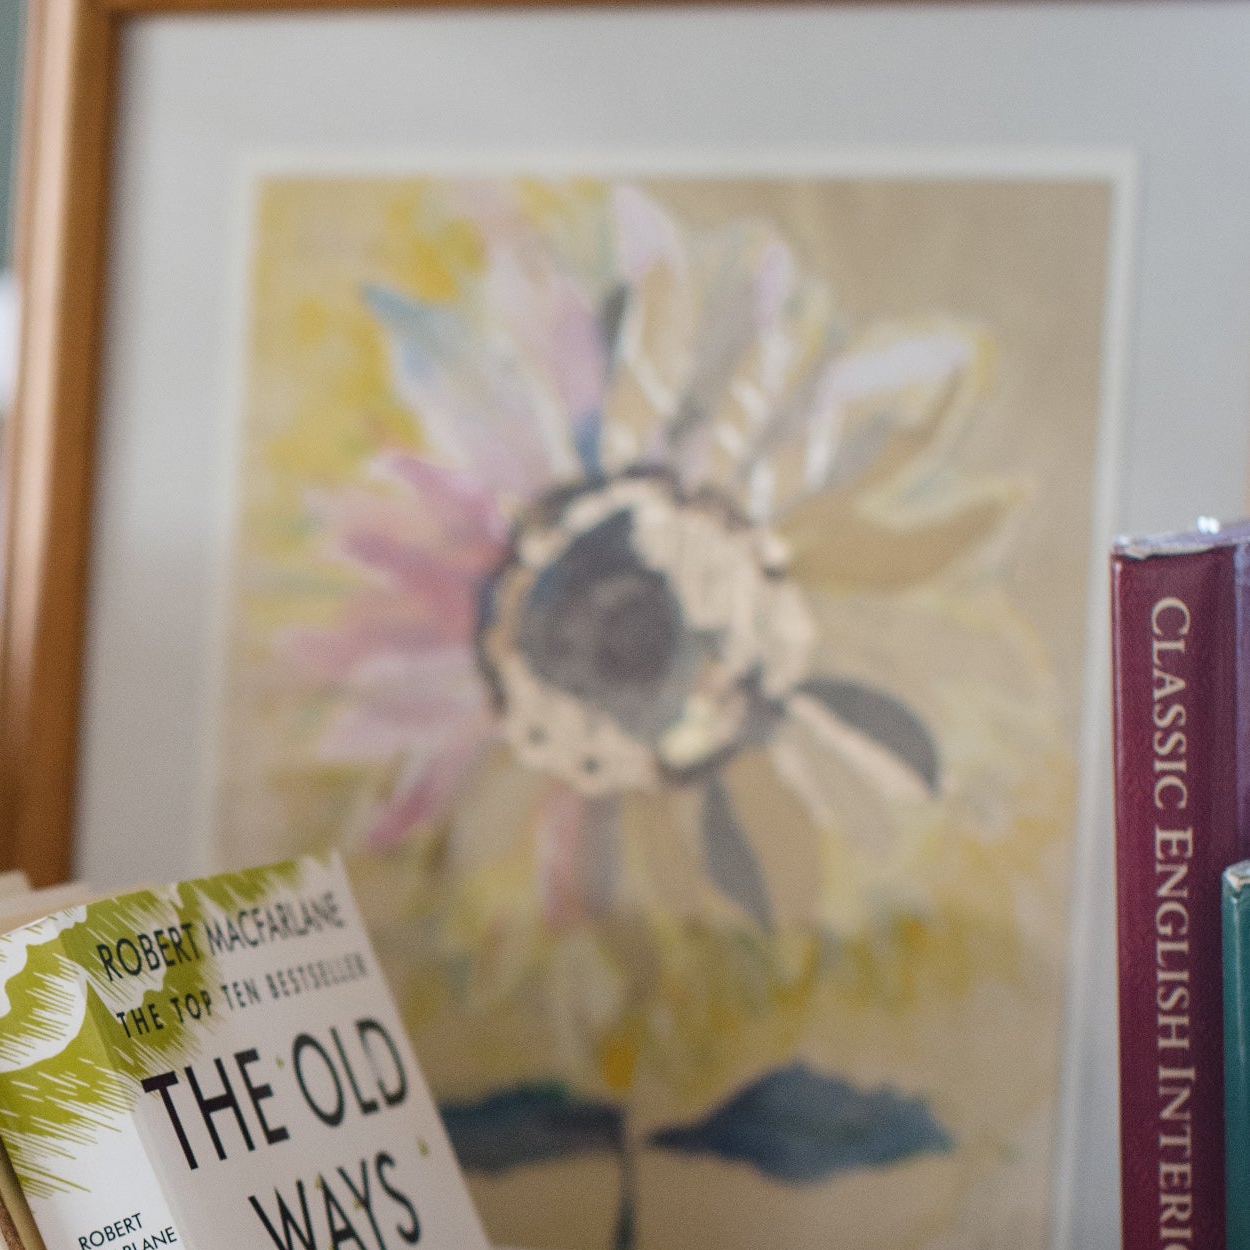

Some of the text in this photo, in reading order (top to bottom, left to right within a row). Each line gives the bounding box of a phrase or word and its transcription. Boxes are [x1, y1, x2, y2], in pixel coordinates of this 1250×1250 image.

[1151, 597, 1191, 810] CLASSIC
[96, 890, 344, 982] ROBERT MACFARLANE
[116, 952, 368, 1038] THE TOP TEN BESTSELLER
[1154, 827, 1194, 1050] ENGLISH
[141, 1017, 408, 1171] THE OLD
